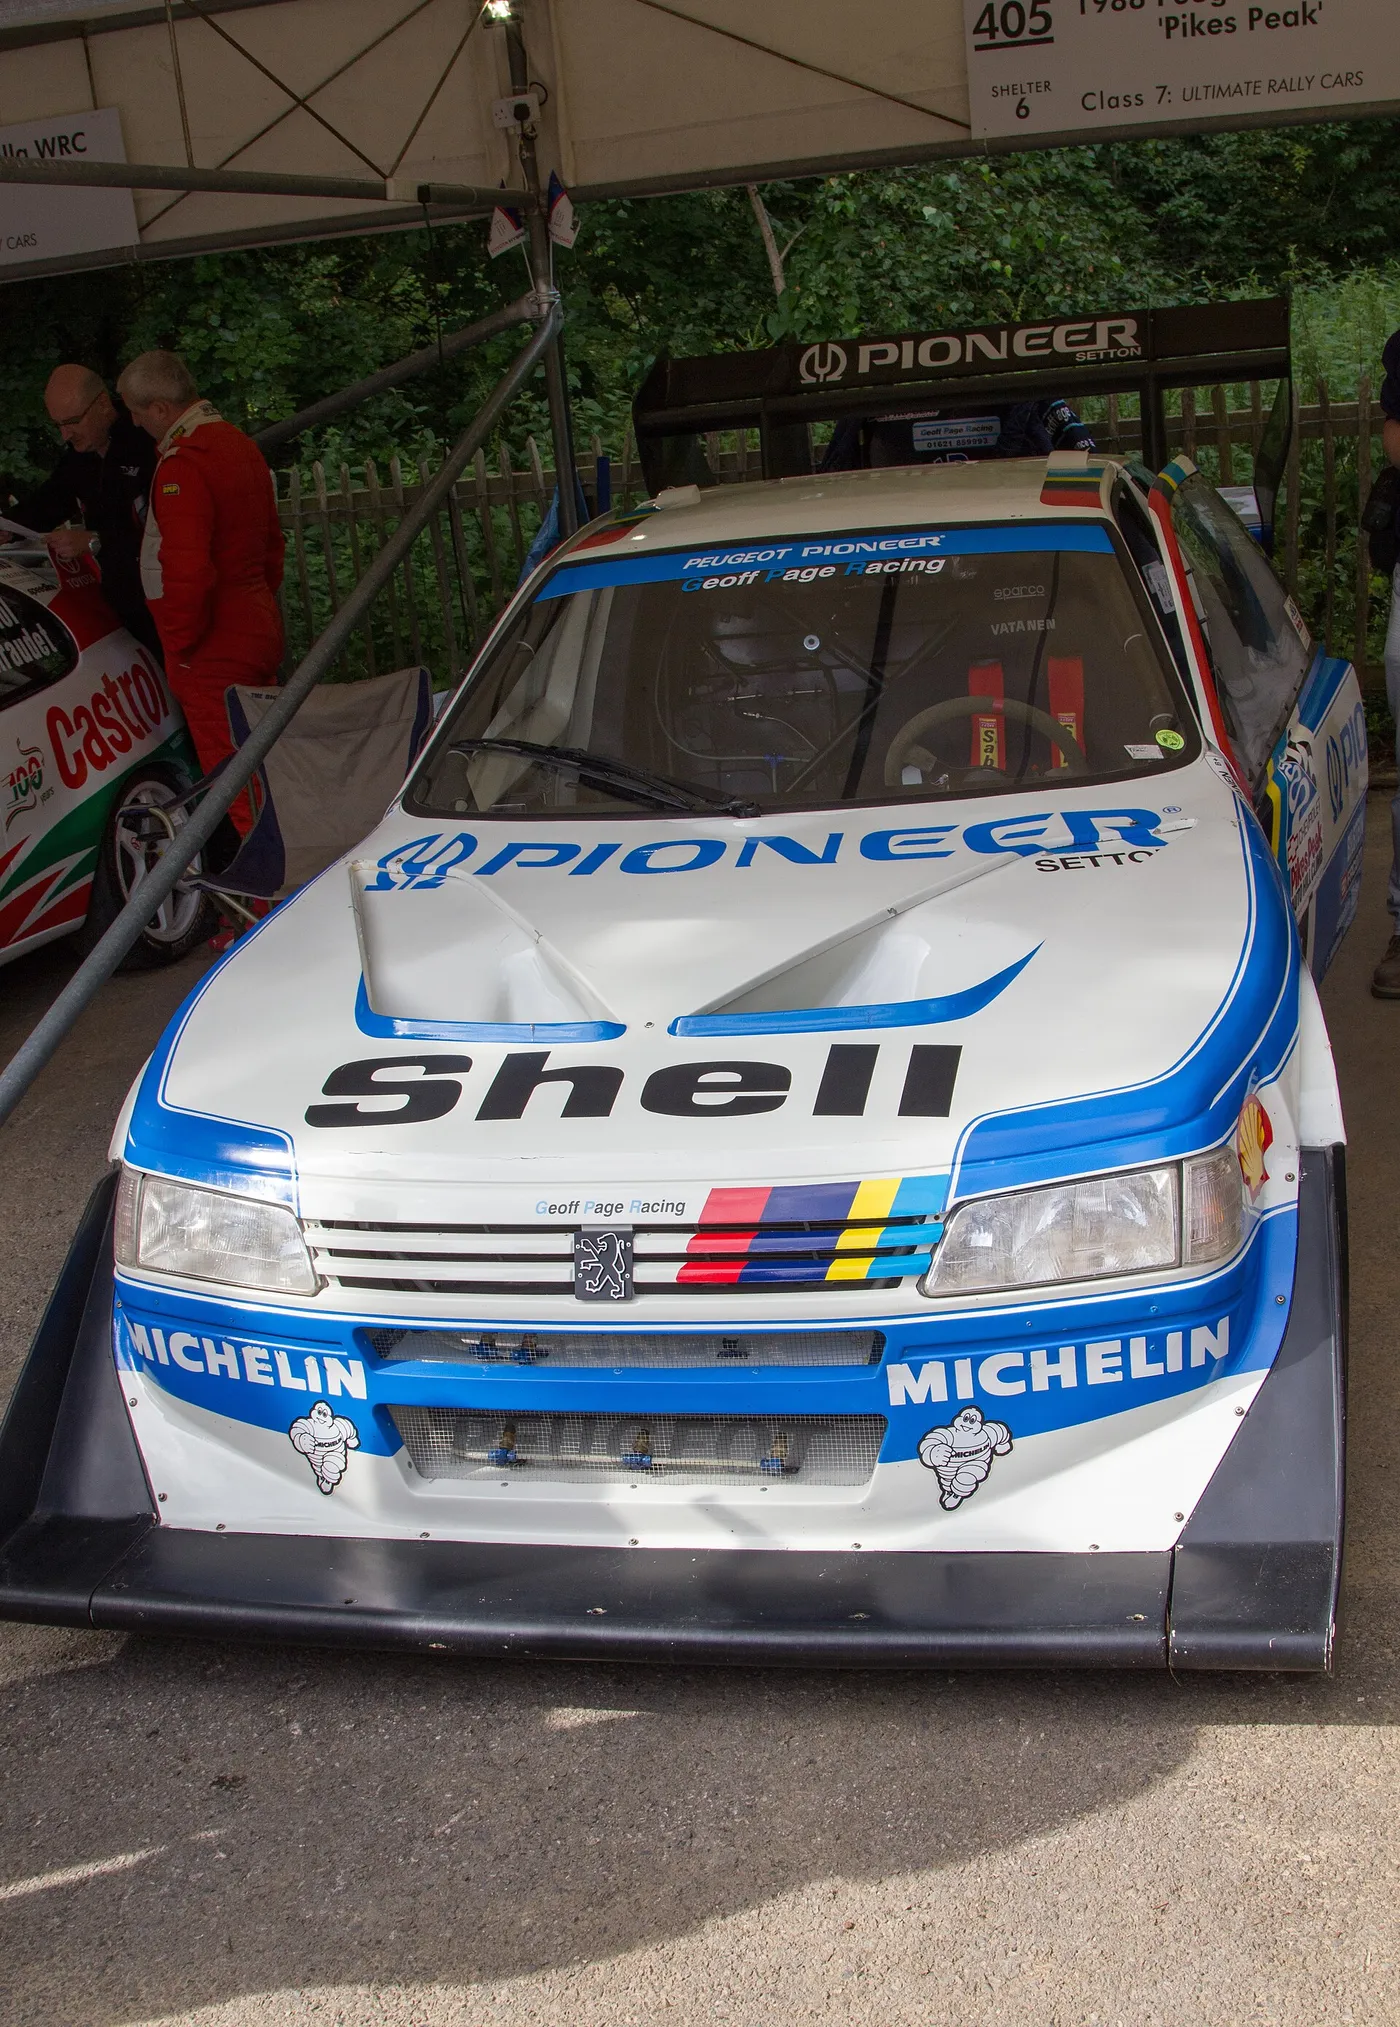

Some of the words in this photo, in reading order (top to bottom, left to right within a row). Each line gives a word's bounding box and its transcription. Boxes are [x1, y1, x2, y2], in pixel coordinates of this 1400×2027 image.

[973, 0, 1053, 40] 405
[1158, 12, 1237, 39] 'Pikes
[1249, 1, 1322, 31] Peak'
[992, 80, 1051, 98] SHELTER
[1081, 90, 1144, 111] Class
[1156, 85, 1172, 105] 7:
[1182, 80, 1262, 102] ULTIMATE
[1267, 75, 1315, 94] RALLY
[1320, 71, 1364, 89] CARS
[1015, 97, 1030, 120] 6
[34, 132, 88, 159] WRC
[6, 233, 37, 250] CARS
[858, 318, 1140, 373] PIONEER
[1075, 346, 1142, 362] SETTON
[920, 428, 943, 436] Geoff
[943, 426, 964, 435] Page
[965, 425, 993, 434] Racing
[927, 441, 952, 449] 01621
[683, 548, 793, 570] PEUGEOT
[801, 536, 943, 558] PIONEER
[681, 570, 760, 593] Geoff
[765, 566, 836, 583] Page
[845, 558, 946, 576] Racing
[993, 585, 1045, 601] sparco
[46, 648, 170, 790] Castrol
[9, 757, 43, 801] 100
[473, 808, 1168, 876] PIONEER
[1035, 848, 1160, 873] SETTO
[305, 1044, 963, 1128] Shell
[535, 1201, 580, 1214] Geoff
[584, 1201, 624, 1217] Page
[629, 1199, 686, 1216] Racing
[122, 1312, 367, 1400] MICHELIN
[886, 1316, 1230, 1406] MICHELIN
[951, 1442, 991, 1459] MICHELIN
